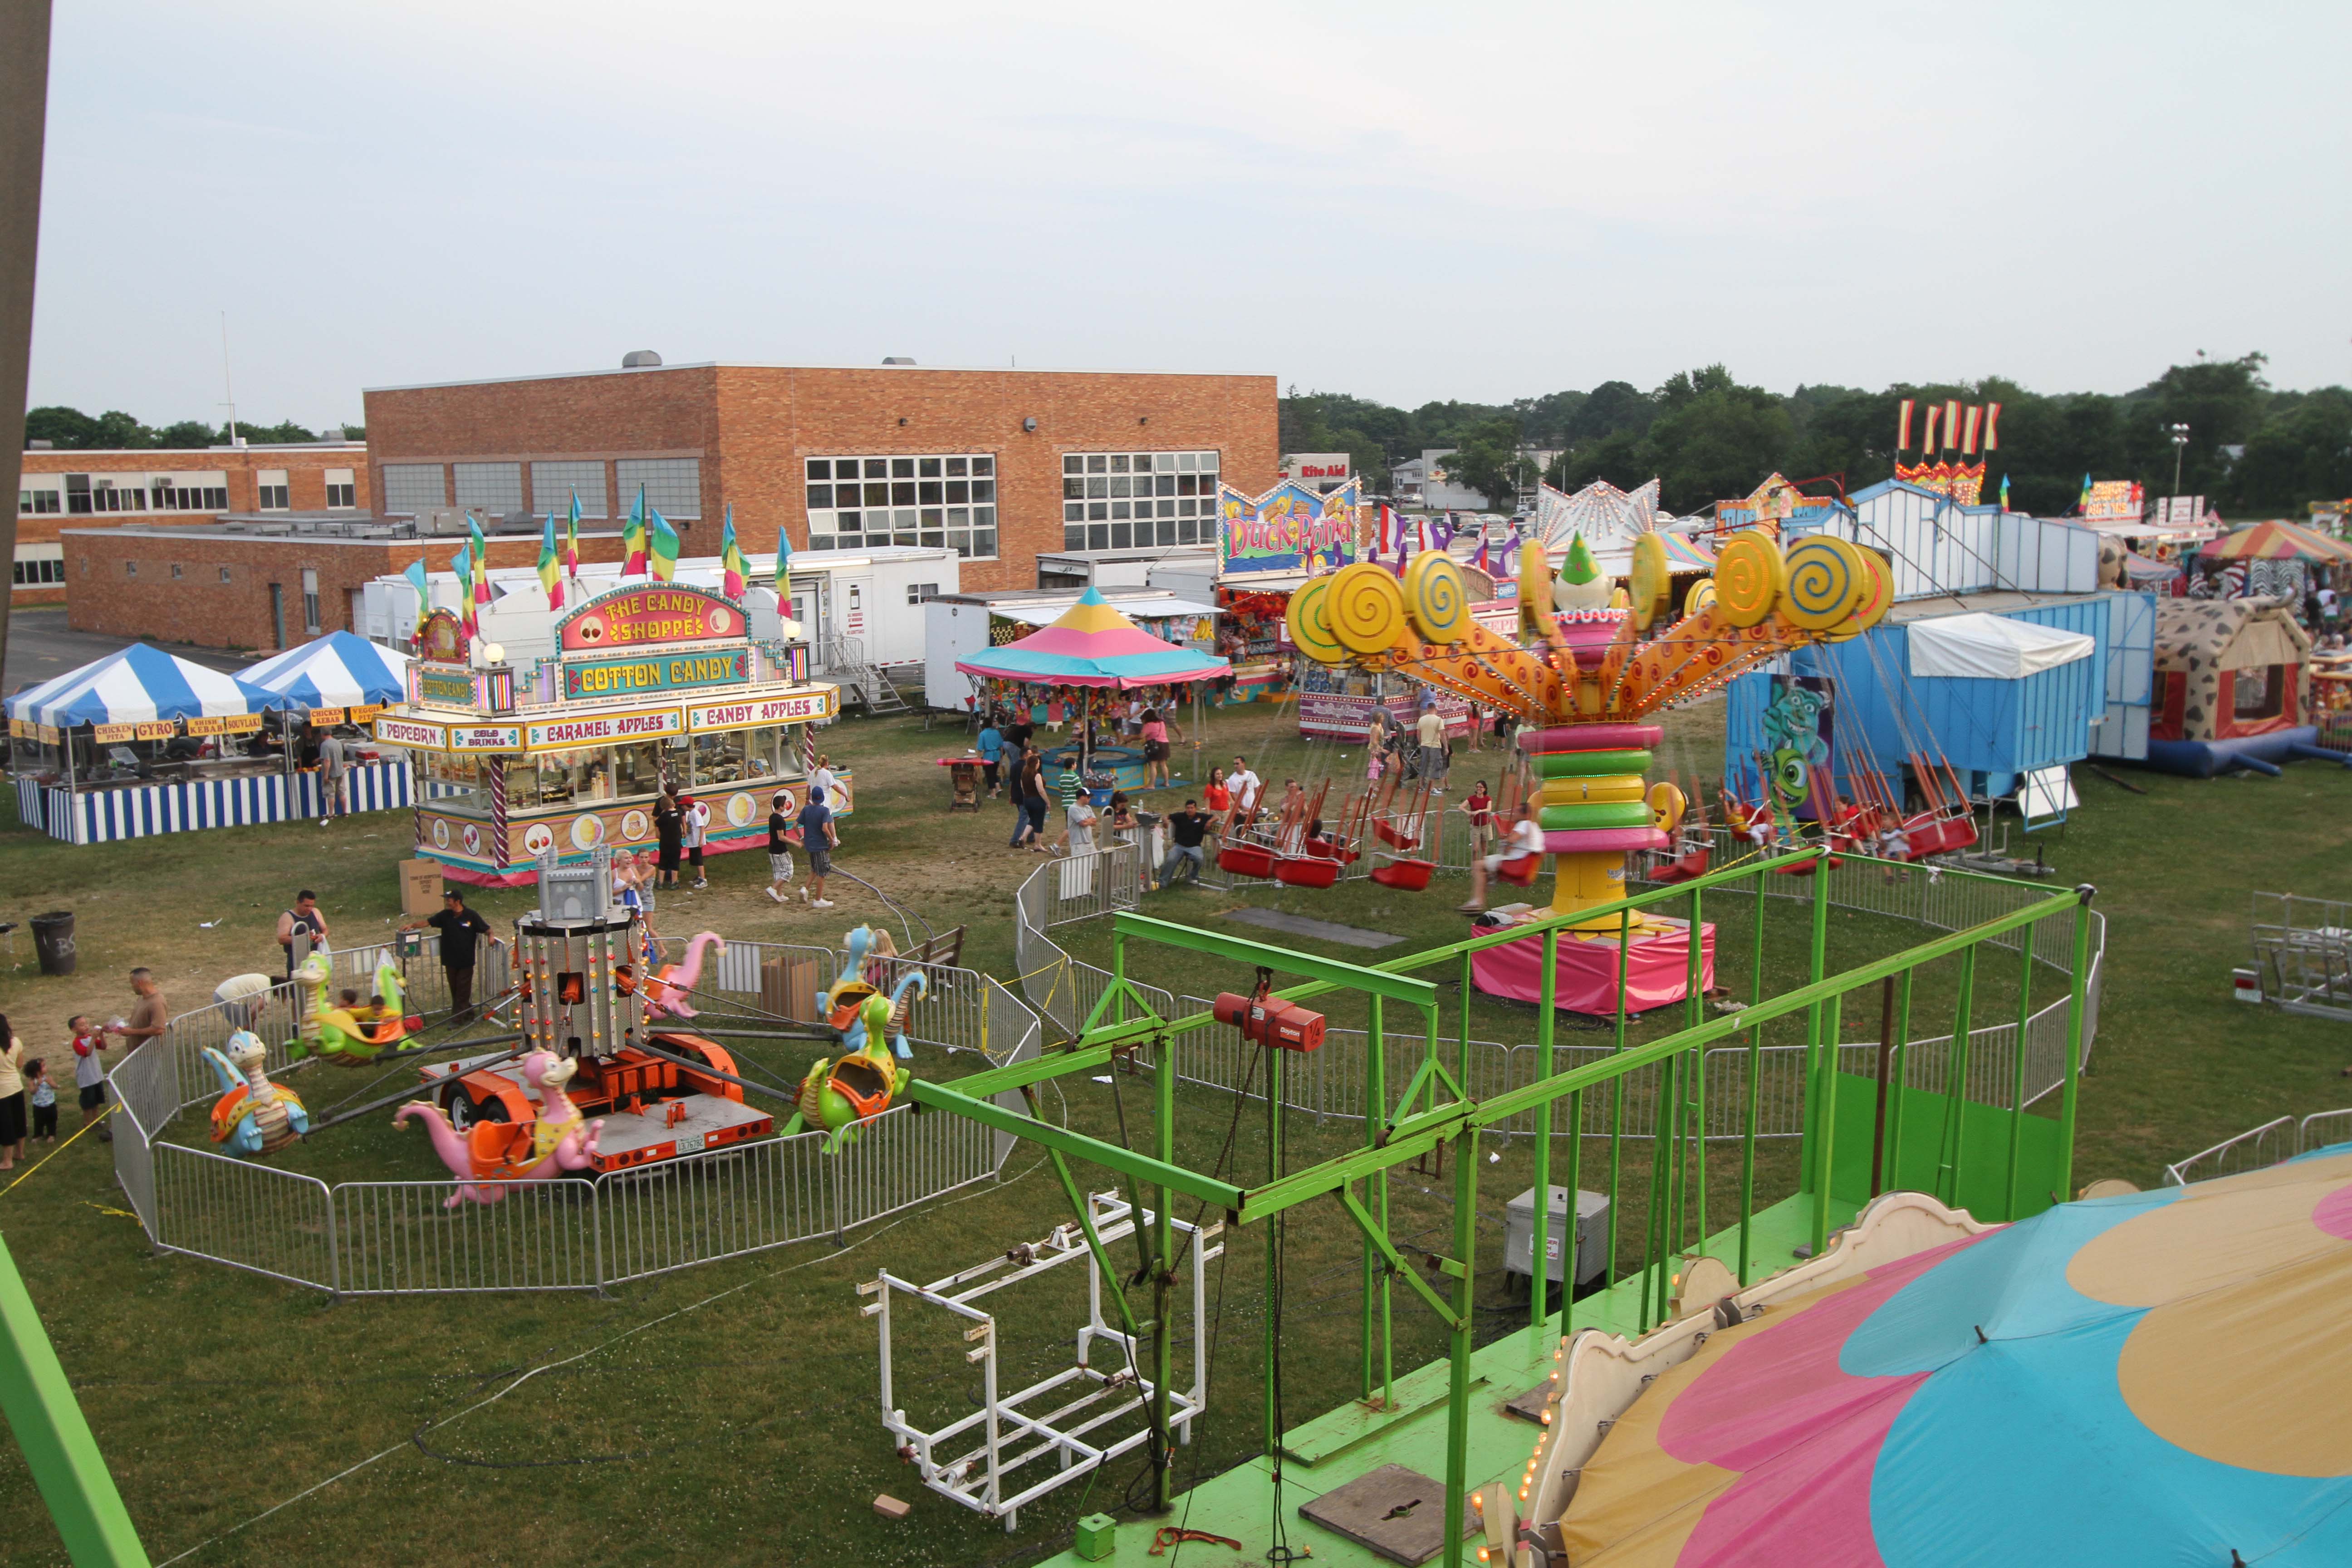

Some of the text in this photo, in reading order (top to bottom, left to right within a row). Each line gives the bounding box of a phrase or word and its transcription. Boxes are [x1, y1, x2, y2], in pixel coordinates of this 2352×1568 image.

[1302, 465, 1325, 477] Rite
[1328, 465, 1346, 476] Aid
[1294, 509, 1353, 554] Pond
[1499, 584, 1516, 595] OREO
[605, 594, 706, 622] THE CANDY
[621, 616, 694, 641] SHOPPÉ
[581, 657, 733, 692] COTTON CANDY
[423, 679, 468, 698] COTTON CANDY
[707, 705, 754, 725] CANDY
[761, 699, 811, 720] APPLES
[97, 725, 132, 734] CHICKEN
[138, 723, 172, 736] GYRO
[190, 725, 223, 734] KEBAB
[228, 718, 260, 729] SOUVLAKI
[547, 715, 664, 742] CARAMEL APPLES
[386, 723, 436, 745] POPCORN
[468, 738, 505, 746] DRINKS
[1280, 1026, 1300, 1037] Dayton
[1309, 1021, 1320, 1040] 1/4
